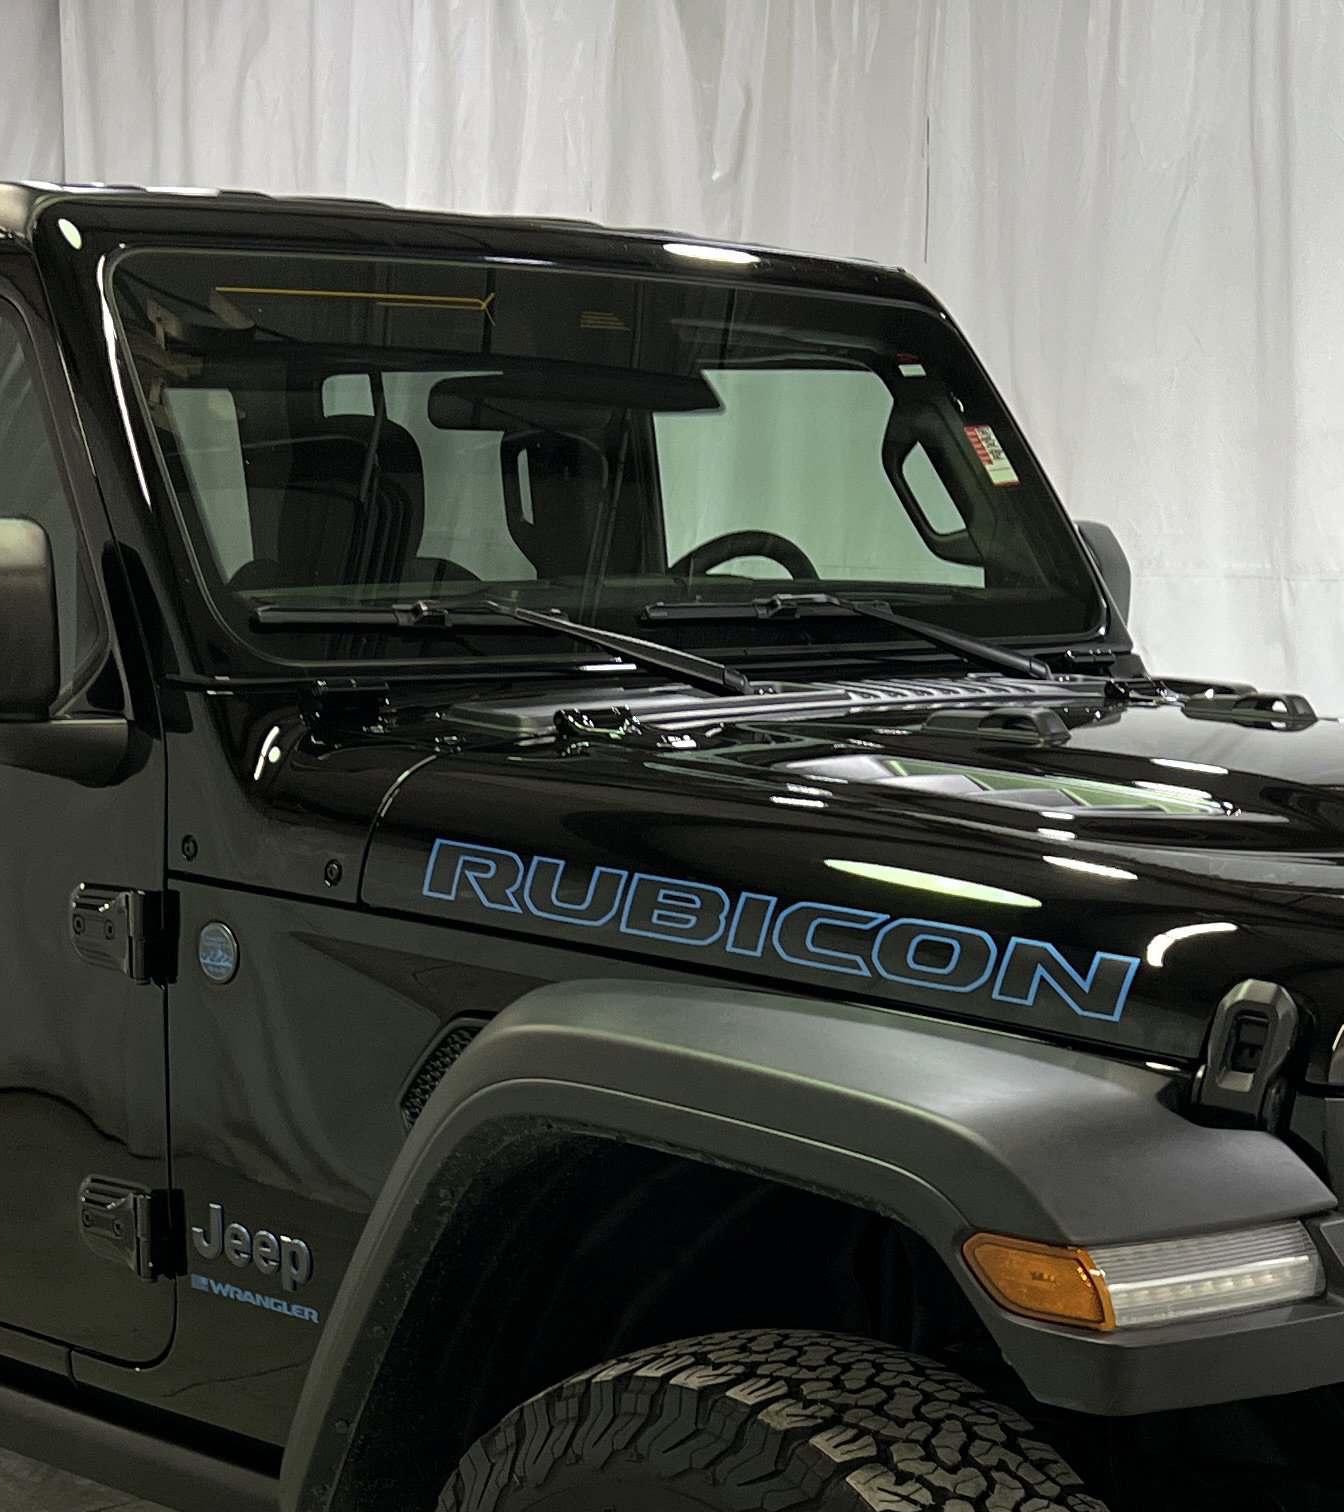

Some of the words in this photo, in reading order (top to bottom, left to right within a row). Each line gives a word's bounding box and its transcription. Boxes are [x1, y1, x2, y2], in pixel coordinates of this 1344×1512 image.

[422, 837, 1141, 1022] RUBICON
[191, 1202, 313, 1292] Jeep
[208, 1279, 320, 1324] WRANGLER
